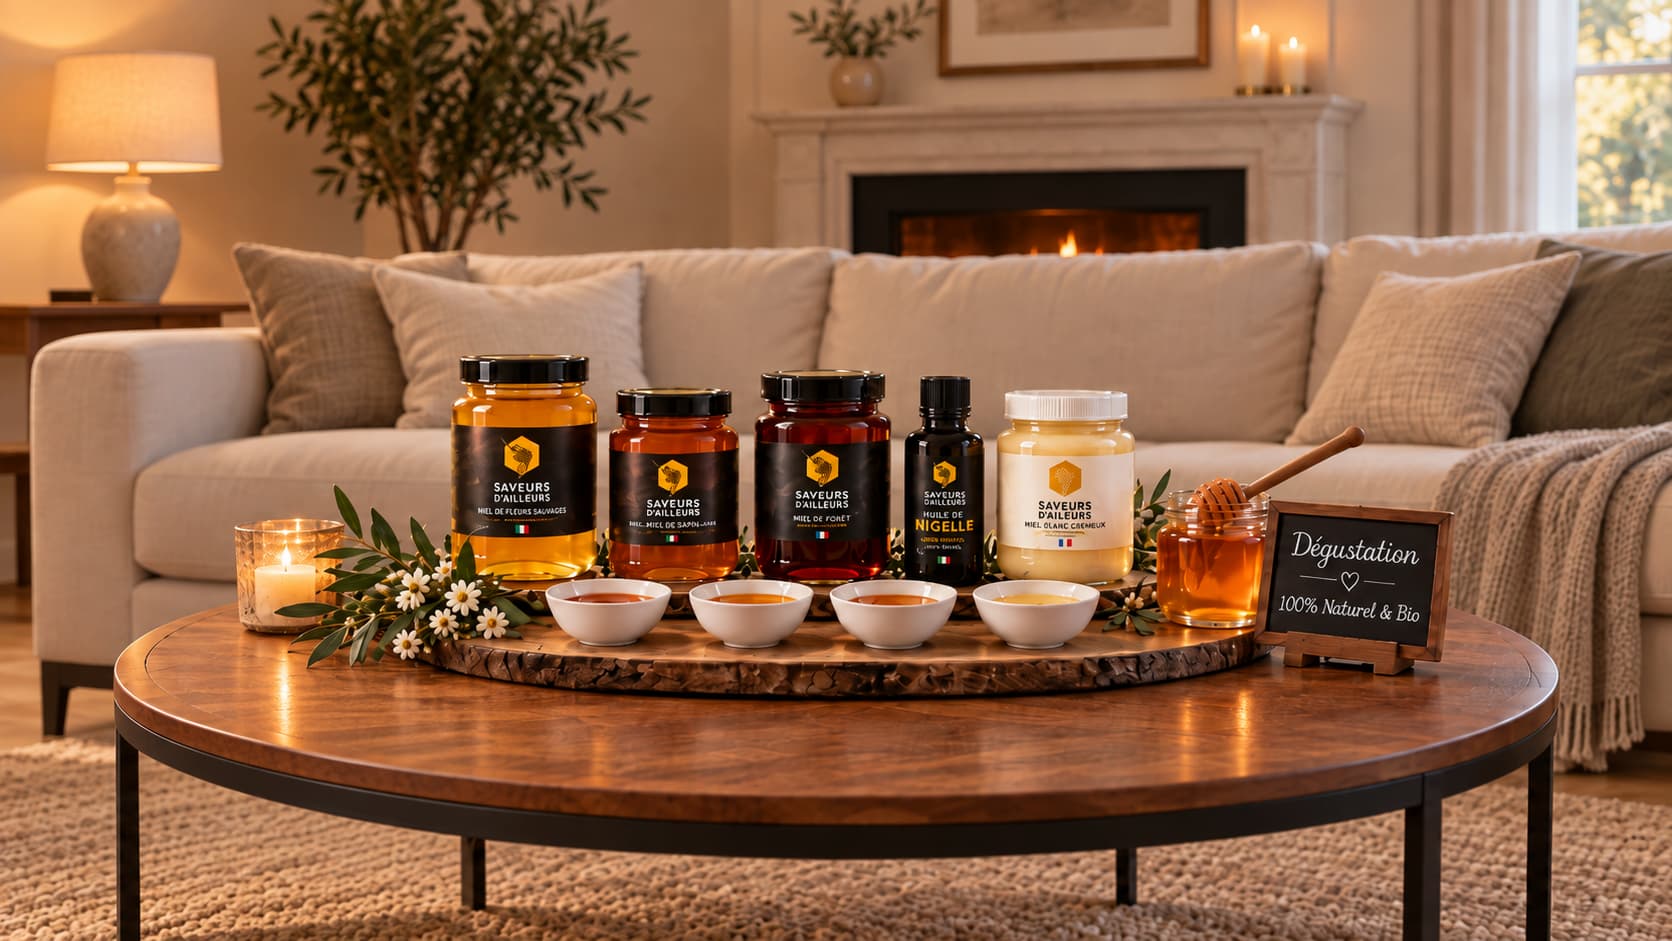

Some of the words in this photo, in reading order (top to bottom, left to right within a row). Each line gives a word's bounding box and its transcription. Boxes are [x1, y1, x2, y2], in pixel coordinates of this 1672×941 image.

[493, 482, 551, 493] SAVEURS
[493, 493, 551, 503] D'AILLEURS
[795, 490, 849, 500] SAVEURS
[924, 491, 966, 499] SAVEURS
[646, 499, 700, 509] SAVEURS
[795, 500, 849, 509] D'AILLEURS
[1038, 501, 1092, 511] SAVEURS
[646, 508, 700, 517] D'AILLEURS
[915, 519, 974, 532] NIGELLE
[1290, 531, 1420, 569] Dégustation
[1278, 595, 1319, 614] 100%
[1321, 598, 1377, 619] Naturel
[1379, 604, 1393, 621] &
[1395, 604, 1421, 623] Bio
